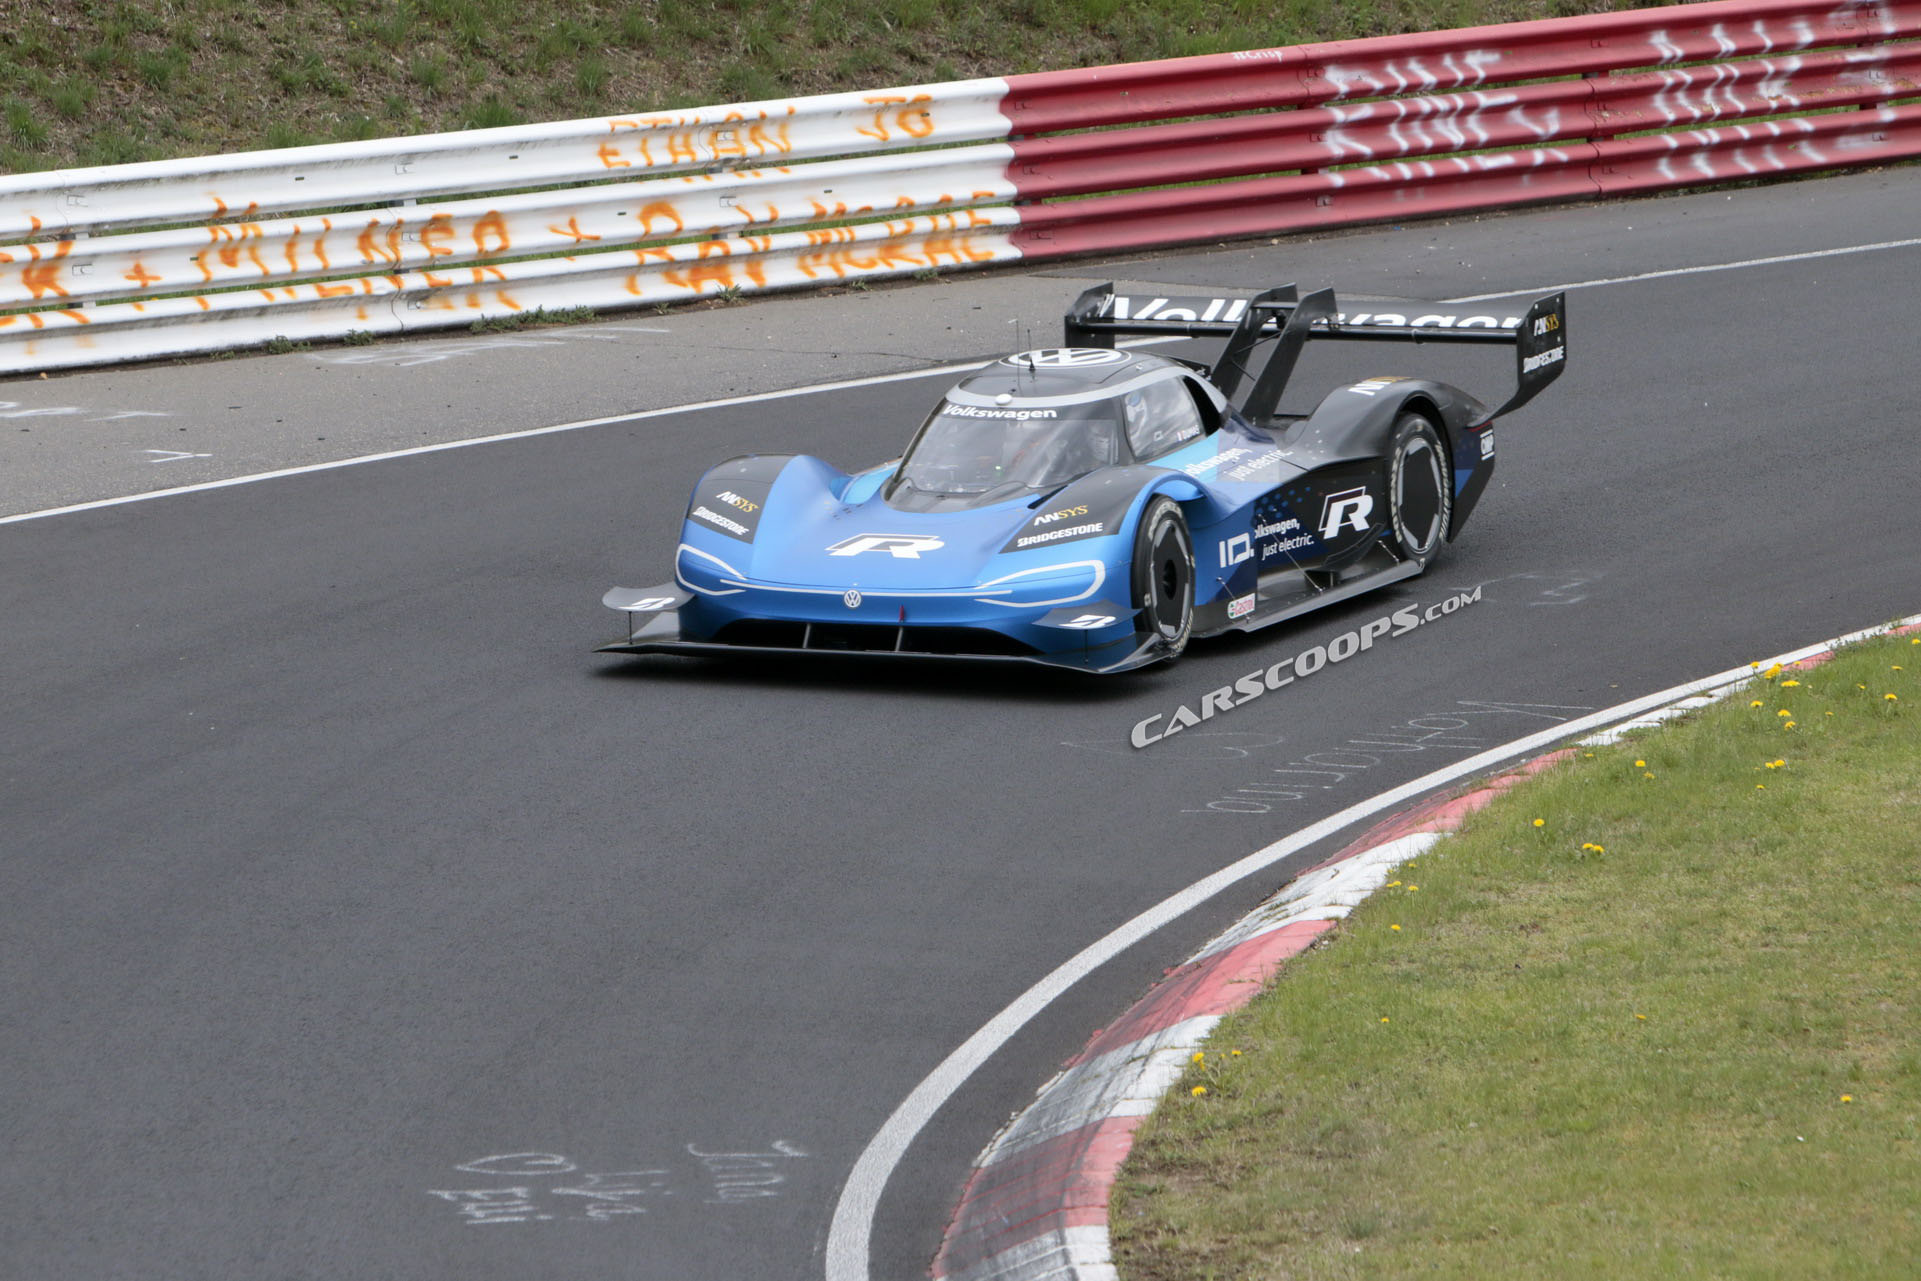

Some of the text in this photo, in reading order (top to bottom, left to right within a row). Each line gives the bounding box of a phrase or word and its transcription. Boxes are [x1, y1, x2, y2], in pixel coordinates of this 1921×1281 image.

[598, 105, 793, 184] ETHAN
[942, 404, 1058, 422] Volkswagen
[1033, 504, 1089, 527] ANSYS
[1318, 486, 1374, 540] R
[824, 532, 945, 560] R
[1016, 521, 1104, 548] BRIDGESTONE
[1262, 532, 1315, 561] just electric.
